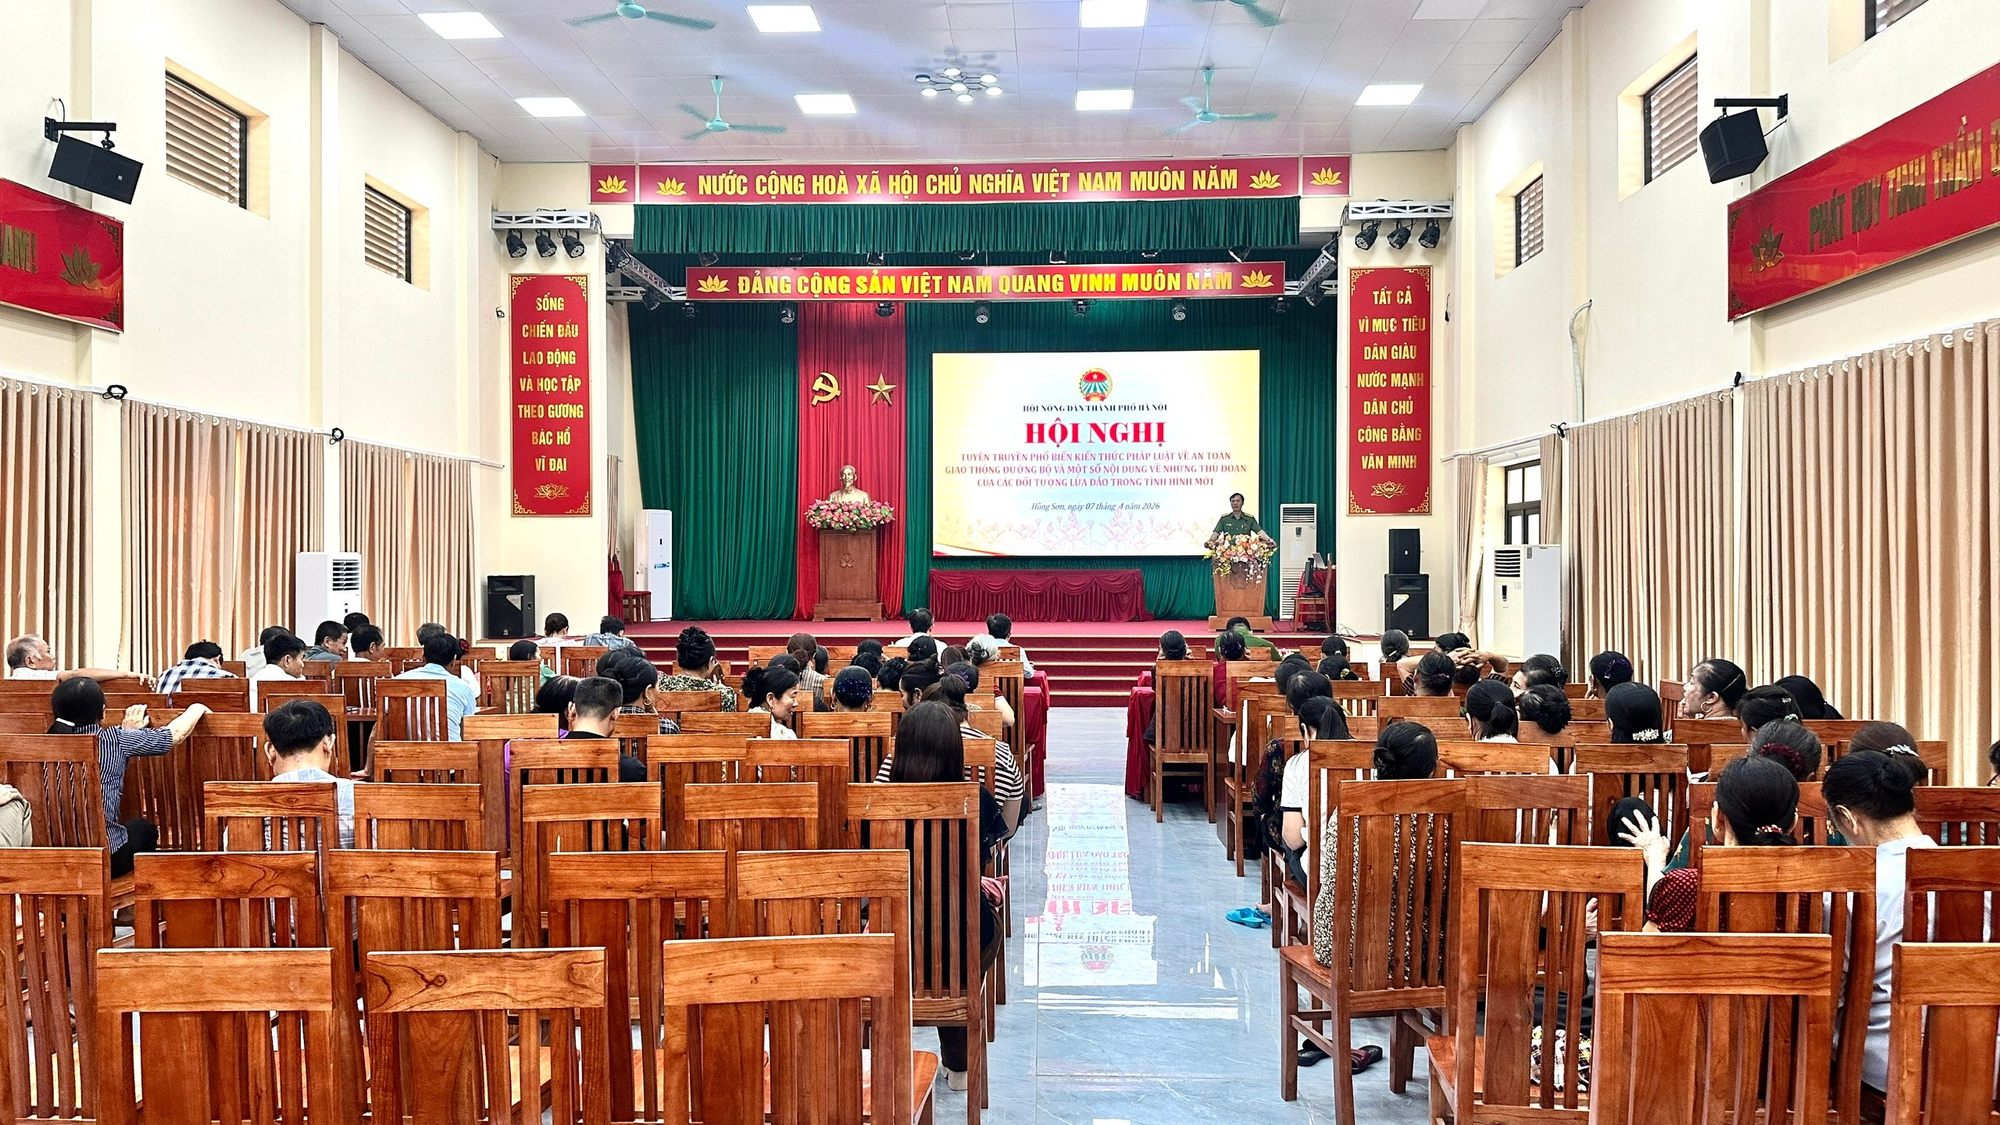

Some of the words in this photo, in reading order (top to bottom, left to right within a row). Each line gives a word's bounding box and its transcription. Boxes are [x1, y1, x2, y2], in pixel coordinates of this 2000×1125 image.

[698, 169, 748, 195] NƯỚC
[755, 170, 806, 199] CỘNG
[812, 170, 849, 195] HOÀ
[856, 170, 882, 195] XÃ
[888, 170, 918, 199] HỘI
[925, 167, 962, 195] CHỦ
[969, 169, 1025, 194] NGHĨA
[1032, 168, 1070, 198] VIỆT
[1079, 171, 1122, 192] NAM
[1130, 166, 1185, 191] MUÔN
[1192, 165, 1238, 190] NĂM
[1809, 188, 1846, 253] PHÁT
[1852, 174, 1882, 234] HUY
[1886, 155, 1926, 219] TINH
[1932, 115, 1982, 201] THẦN
[0, 223, 37, 275] AM!
[738, 270, 792, 294] ĐẢNG
[797, 272, 850, 298] CỘNG
[856, 270, 895, 294] SẢN
[901, 272, 942, 298] VIỆT
[948, 275, 992, 293] NAM
[998, 274, 1064, 294] QUANG
[1069, 273, 1116, 293] VINH
[1121, 269, 1181, 292] MUÔN
[1186, 268, 1232, 290] NĂM
[535, 292, 565, 312] SỐNG
[1373, 285, 1392, 305] TẤT
[1396, 285, 1412, 305] CẢ
[521, 319, 554, 338] CHIẾN
[557, 319, 579, 338] ĐẤU
[1358, 317, 1369, 333] VÌ
[1372, 317, 1397, 335] MỤC
[1402, 315, 1426, 332] TIÊU
[522, 350, 543, 365] LAO
[547, 348, 576, 368] ĐỘNG
[1364, 342, 1388, 360] DÂN
[1391, 342, 1417, 360] GIÀU
[519, 376, 534, 392] VÀ
[536, 378, 558, 395] HỌC
[561, 375, 581, 395] TẬP
[1357, 370, 1387, 388] NƯỚC
[1390, 373, 1424, 390] MẠNH
[518, 404, 544, 419] THEO
[548, 403, 584, 419] GƯƠNG
[1023, 404, 1039, 413] HỘI
[1041, 404, 1065, 413] NÔNG
[1067, 404, 1084, 412] DÂN
[1085, 403, 1116, 412] THÀNH
[1118, 403, 1137, 412] PHỐ
[1139, 403, 1150, 411] HÀ
[1152, 403, 1167, 412] NỘI
[1363, 398, 1387, 415] DÂN
[1391, 396, 1414, 415] CHỦ
[531, 428, 553, 446] BÁC
[556, 425, 571, 445] HỒ
[1024, 417, 1081, 448] HỘI
[1087, 422, 1166, 447] NGHỊ
[1357, 425, 1388, 442] CÔNG
[1391, 422, 1422, 442] BẰNG
[535, 455, 546, 472] VĨ
[549, 457, 567, 474] ĐẠI
[960, 451, 991, 462] TUYÊN
[992, 451, 1028, 462] TRUYỀN
[1030, 451, 1049, 461] PHỔ
[1051, 450, 1072, 461] BIẾN
[1074, 450, 1096, 461] KIẾN
[1098, 450, 1125, 461] THỨC
[1126, 451, 1151, 461] PHÁP
[1153, 451, 1175, 462] LUẬT
[1177, 450, 1189, 460] VỀ
[1191, 452, 1204, 460] AN
[1205, 450, 1231, 460] TOÀN
[1361, 452, 1384, 470] VĂN
[1387, 455, 1417, 469] MINH
[945, 465, 967, 474] GIAO
[968, 464, 1001, 474] THÔNG
[1002, 463, 1037, 474] ĐƯỜNG
[1039, 464, 1052, 476] BỘ
[1054, 463, 1065, 474] VÀ
[1067, 463, 1088, 476] MỘT
[1089, 463, 1101, 474] SỐ
[1103, 463, 1120, 476] NỘI
[1121, 465, 1147, 473] DUNG
[1149, 462, 1161, 473] VỀ
[1163, 463, 1197, 473] NHỮNG
[1199, 462, 1218, 473] THỦ
[1220, 464, 1247, 475] ĐOẠN
[977, 476, 995, 487] CỦA
[996, 476, 1014, 487] CÁC
[1015, 476, 1032, 487] ĐỐI
[1033, 477, 1068, 489] TƯỢNG
[1069, 476, 1087, 487] LỪA
[1089, 476, 1109, 487] ĐẢO
[1111, 477, 1142, 487] TRONG
[1144, 476, 1167, 486] TÌNH
[1169, 476, 1192, 486] HÌNH
[1194, 475, 1214, 486] MỚI
[1031, 502, 1050, 512] Hồng
[1051, 502, 1066, 511] Sơn,
[1067, 503, 1085, 512] ngày
[1085, 502, 1095, 510] 07
[1095, 502, 1116, 512] tháng
[1118, 502, 1124, 510] 4
[1124, 502, 1141, 510] năm
[1141, 502, 1161, 510] 2026
